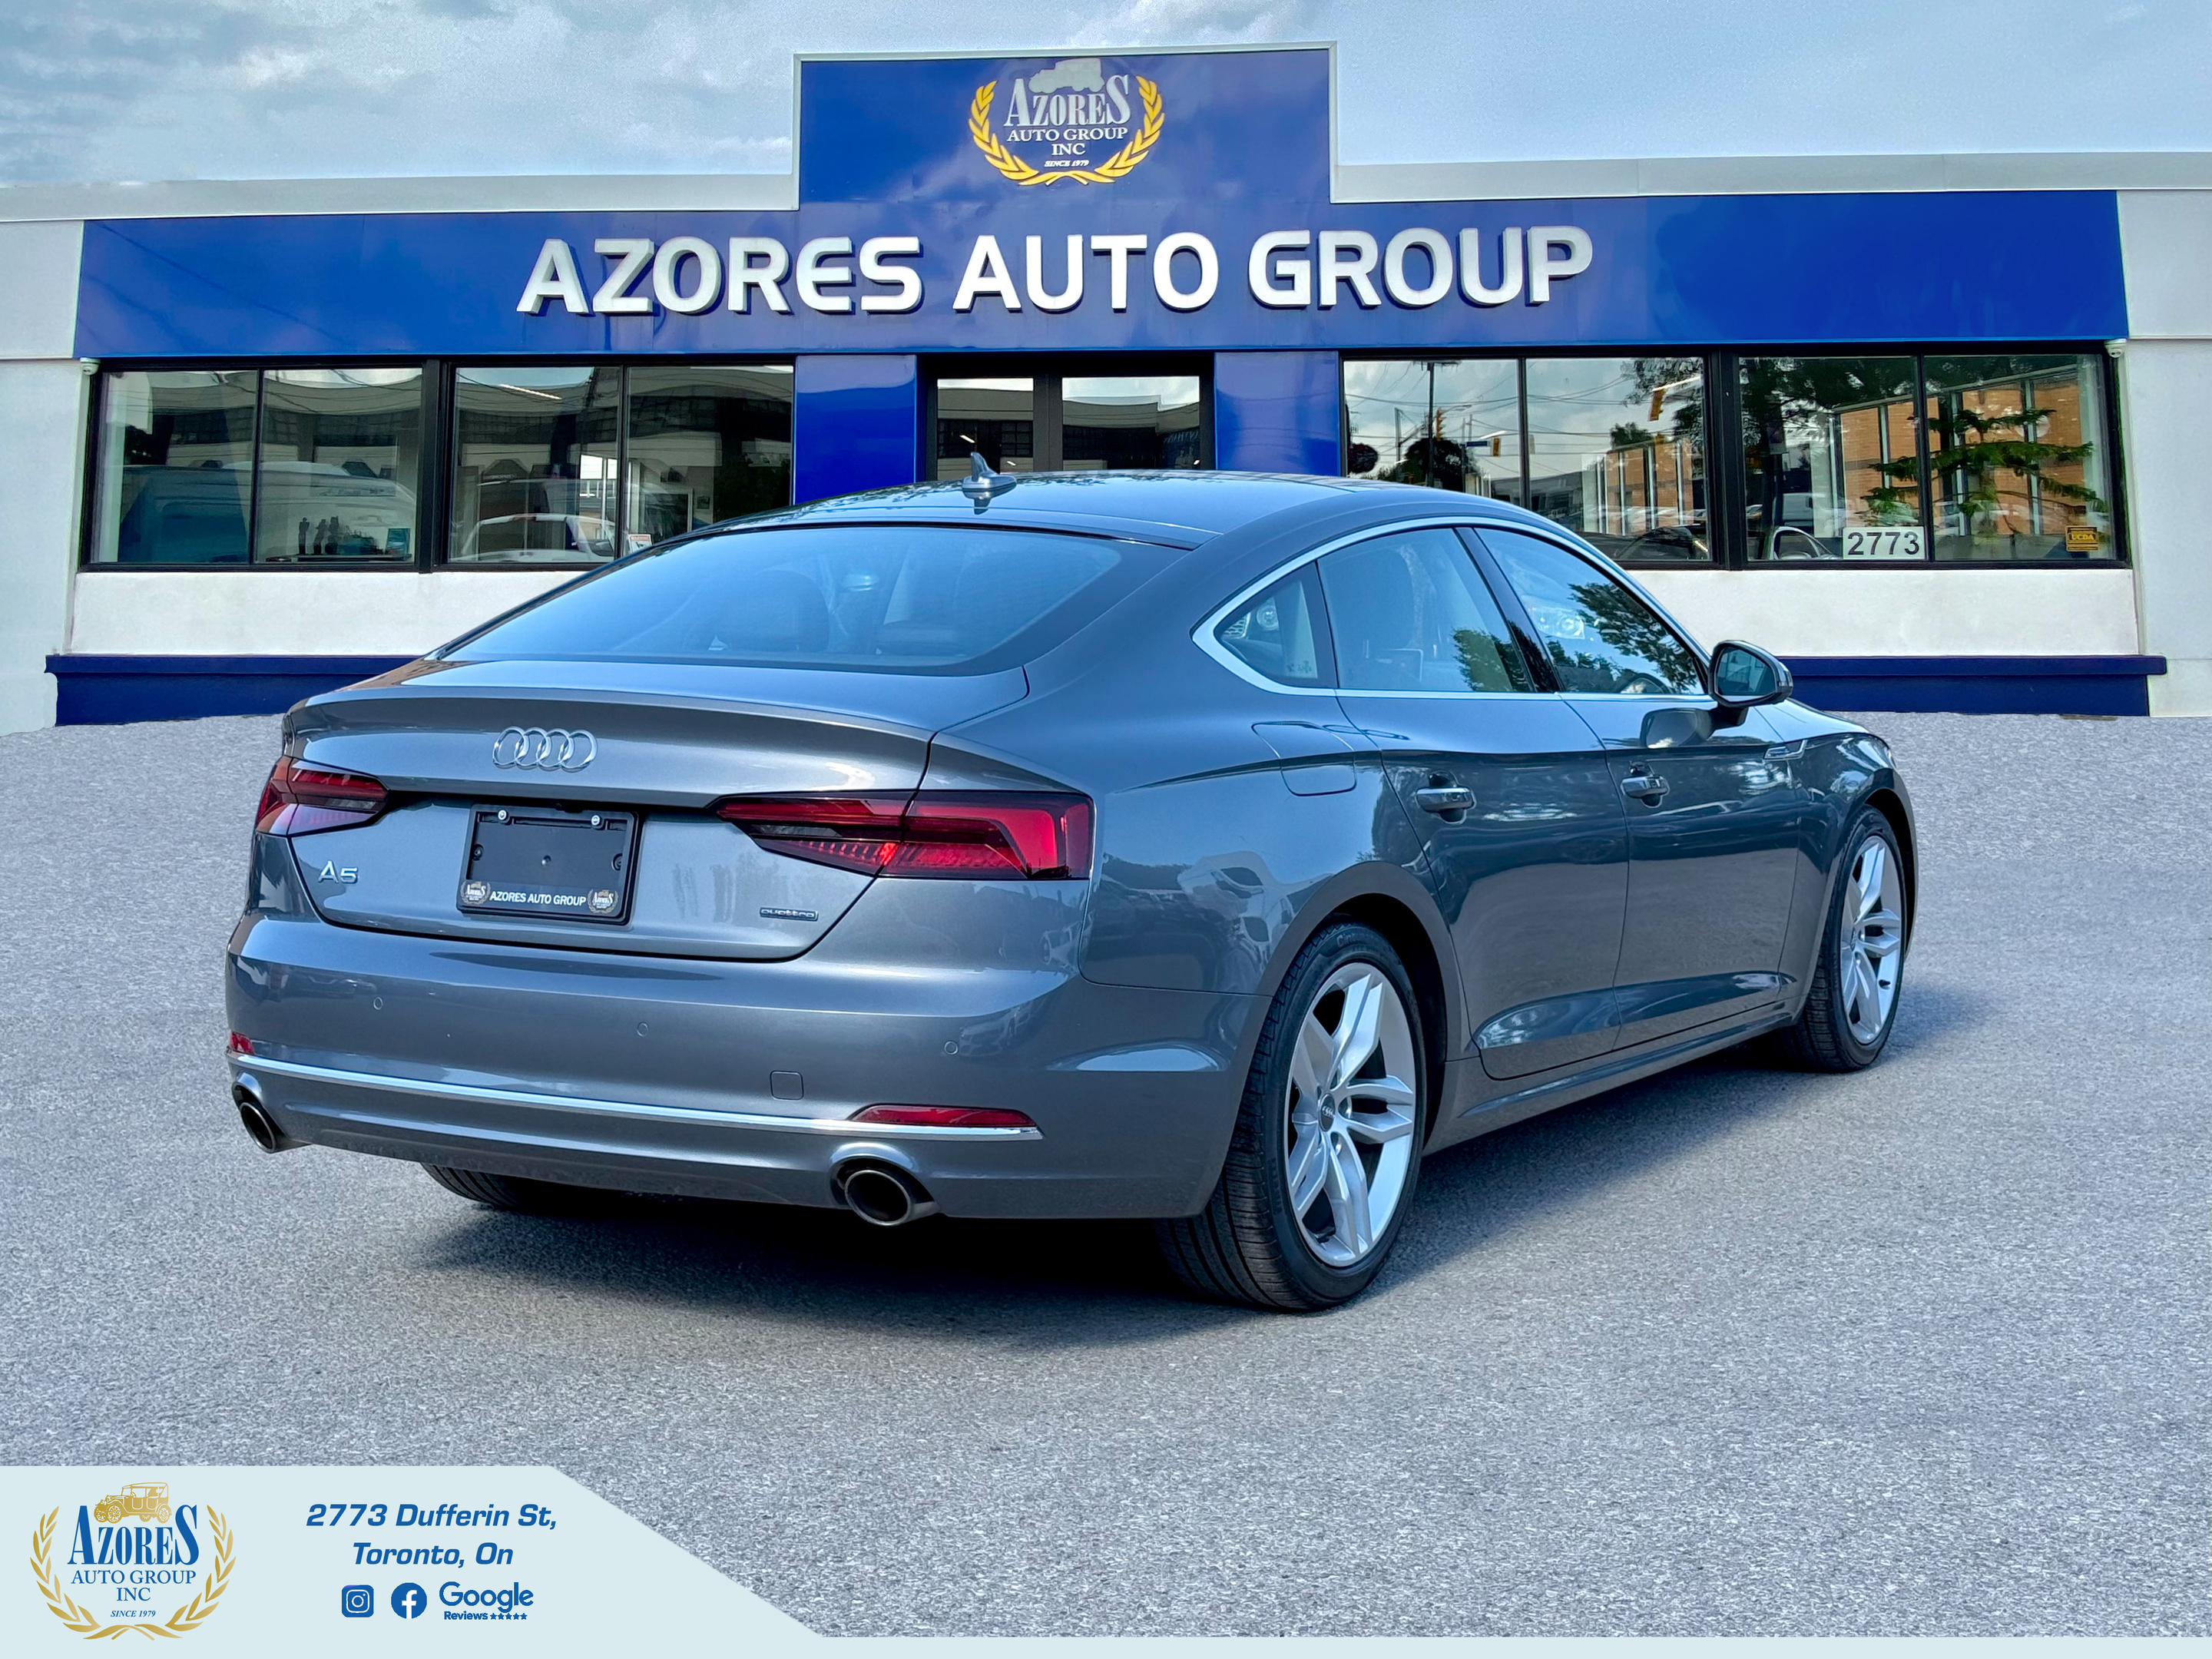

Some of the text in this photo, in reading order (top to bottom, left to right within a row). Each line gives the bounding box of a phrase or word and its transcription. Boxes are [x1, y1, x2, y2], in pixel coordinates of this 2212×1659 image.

[1003, 75, 1131, 127] AZORES
[1006, 127, 1128, 142] AUTO GROUP
[1051, 143, 1086, 156] INC
[516, 225, 1594, 315] AZORES AUTO GROUP
[1847, 531, 1920, 555] 2773
[317, 859, 359, 884] A5
[489, 890, 527, 903] AZORES
[527, 892, 552, 905] AUTO
[553, 894, 587, 907] GROUP
[760, 908, 815, 918] quattro
